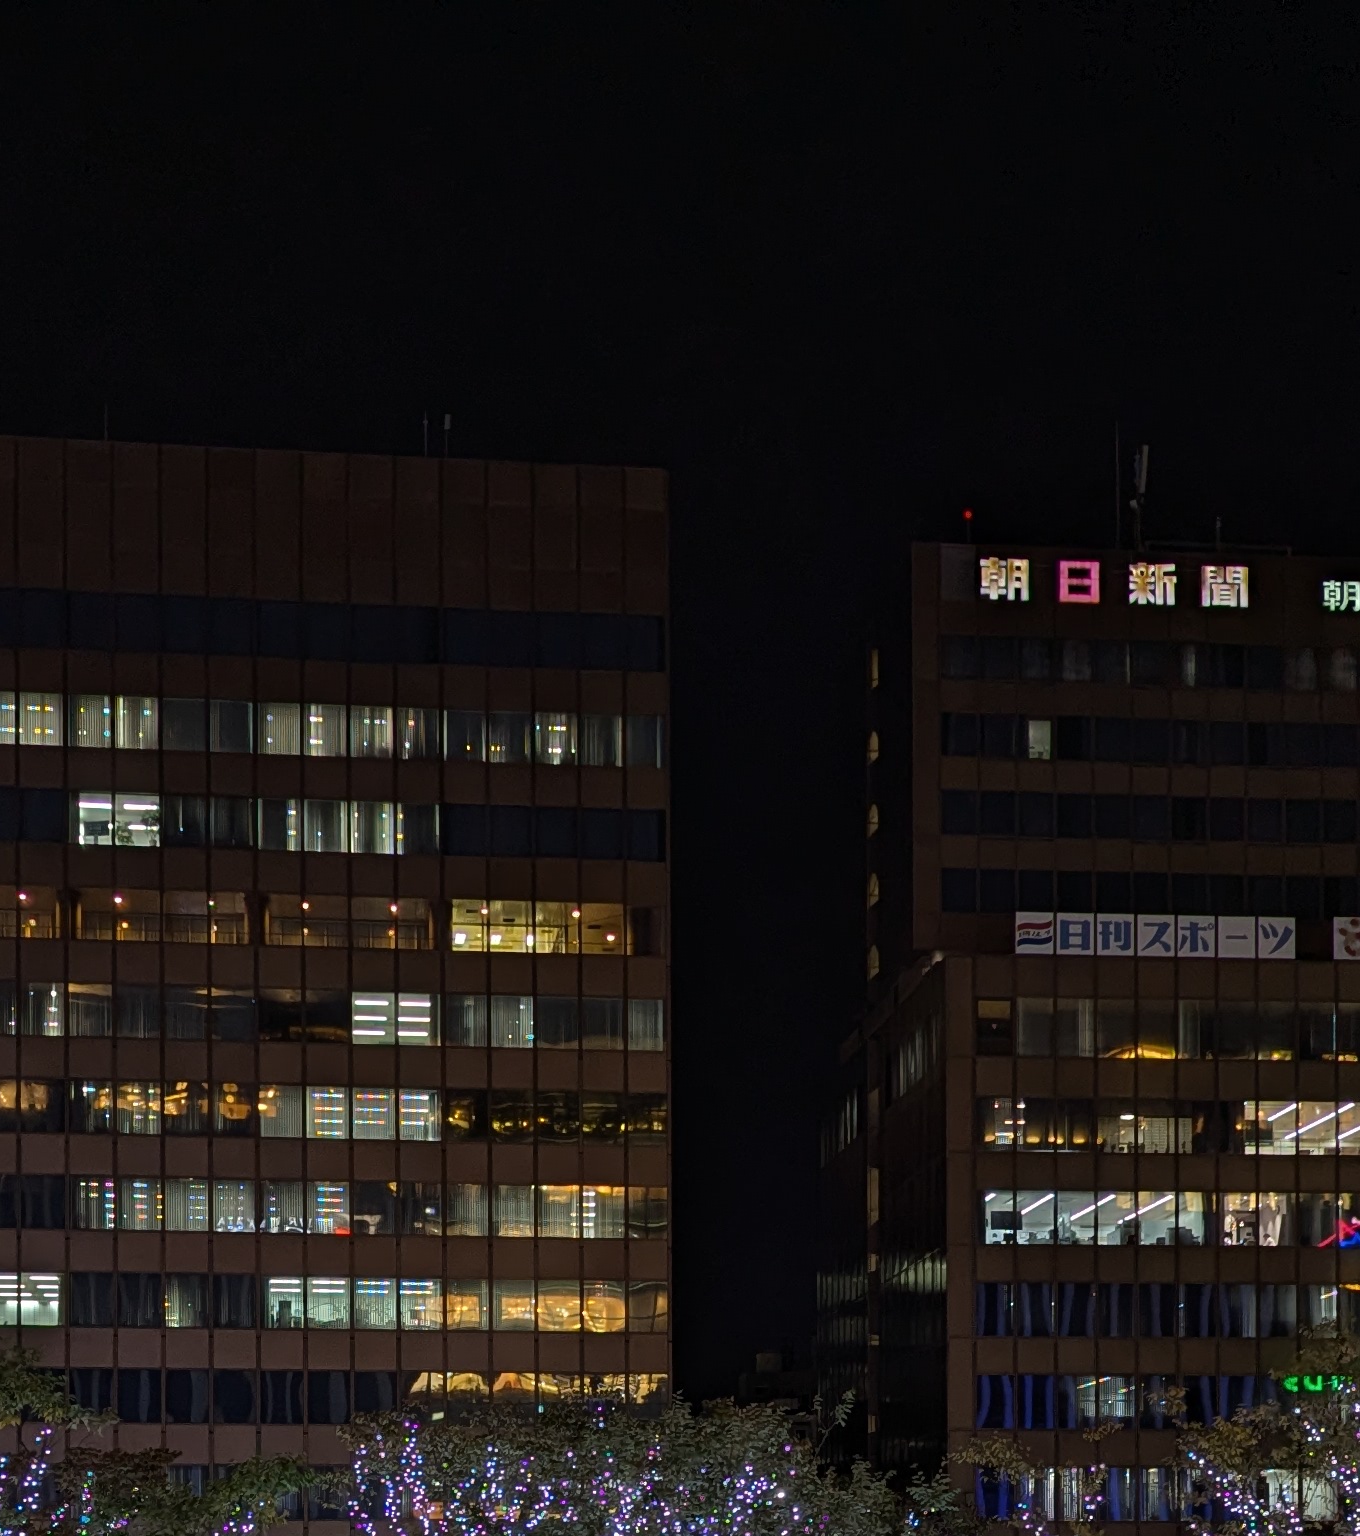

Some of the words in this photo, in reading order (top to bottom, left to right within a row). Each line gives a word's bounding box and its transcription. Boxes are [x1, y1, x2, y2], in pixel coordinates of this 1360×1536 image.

[979, 556, 1250, 609] 朝日新聞
[1059, 919, 1294, 955] 日刊スポーツ
